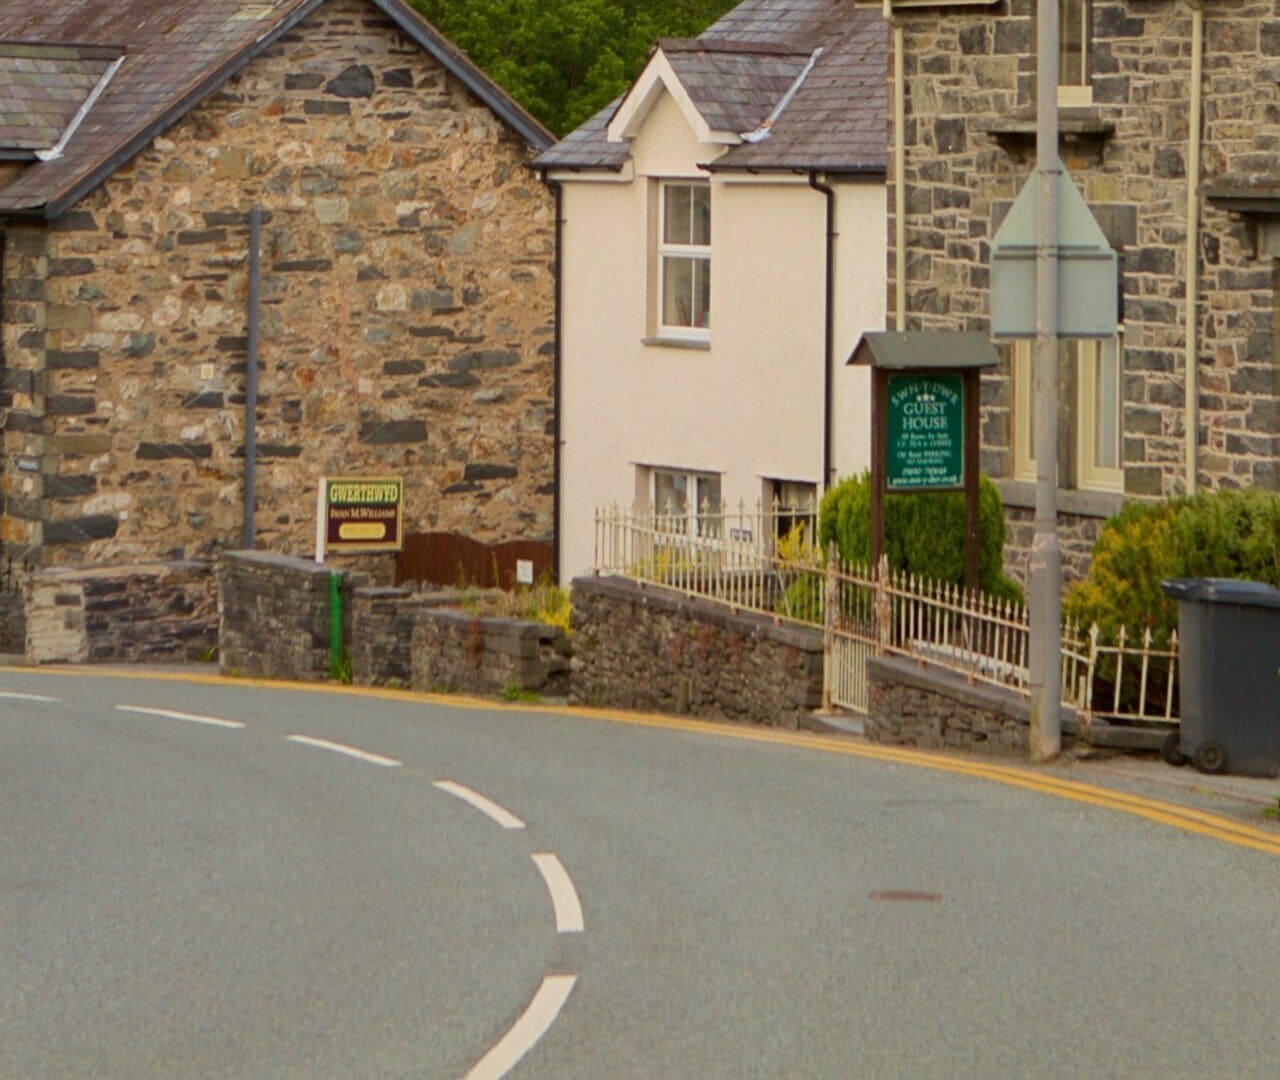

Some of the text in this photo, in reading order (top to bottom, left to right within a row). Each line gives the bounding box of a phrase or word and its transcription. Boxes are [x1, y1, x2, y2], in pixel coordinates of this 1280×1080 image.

[903, 402, 947, 415] GUEST
[902, 417, 948, 430] HOUSE
[330, 484, 398, 503] GWERTHWYD
